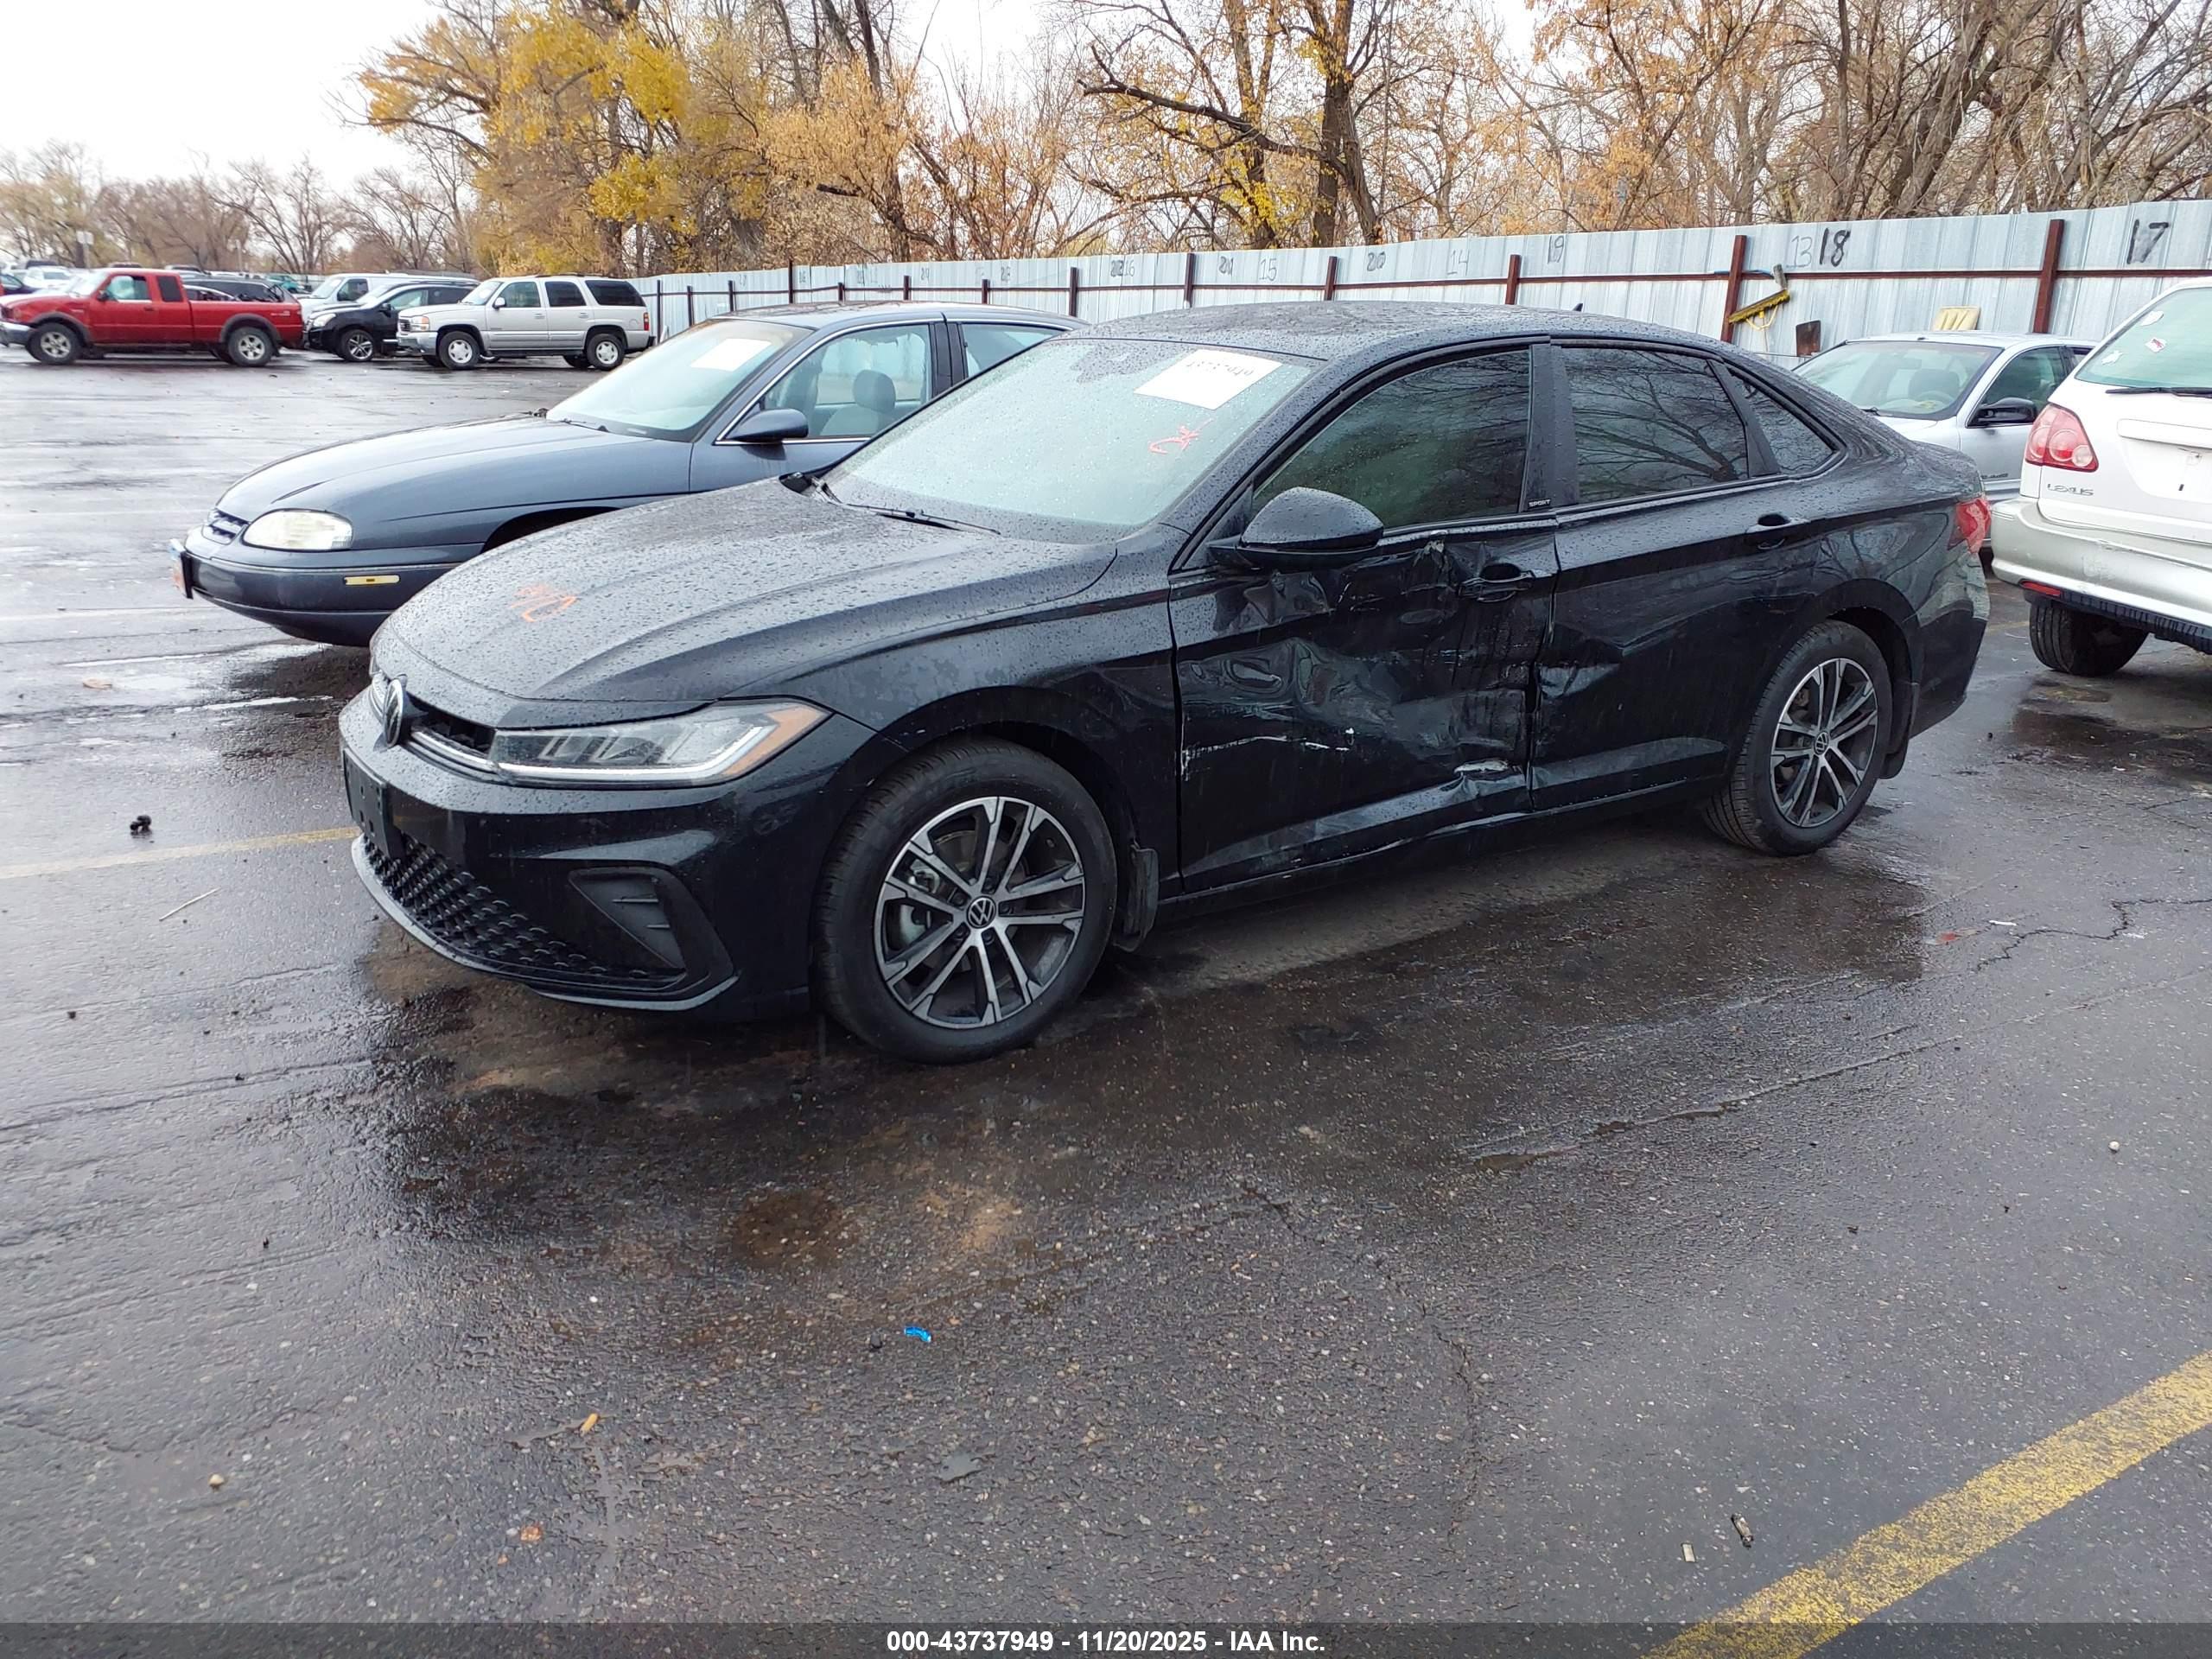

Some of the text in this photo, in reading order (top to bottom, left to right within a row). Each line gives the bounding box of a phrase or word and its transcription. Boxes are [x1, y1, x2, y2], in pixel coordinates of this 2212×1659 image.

[1548, 235, 1565, 264] 19
[1785, 235, 1813, 269] 13
[1819, 227, 1851, 268] 18
[2126, 219, 2169, 264] 17
[1259, 257, 1277, 281] 15
[1446, 250, 1469, 276] 14
[1528, 499, 1551, 507] SPORT
[2047, 483, 2094, 497] LEXUS
